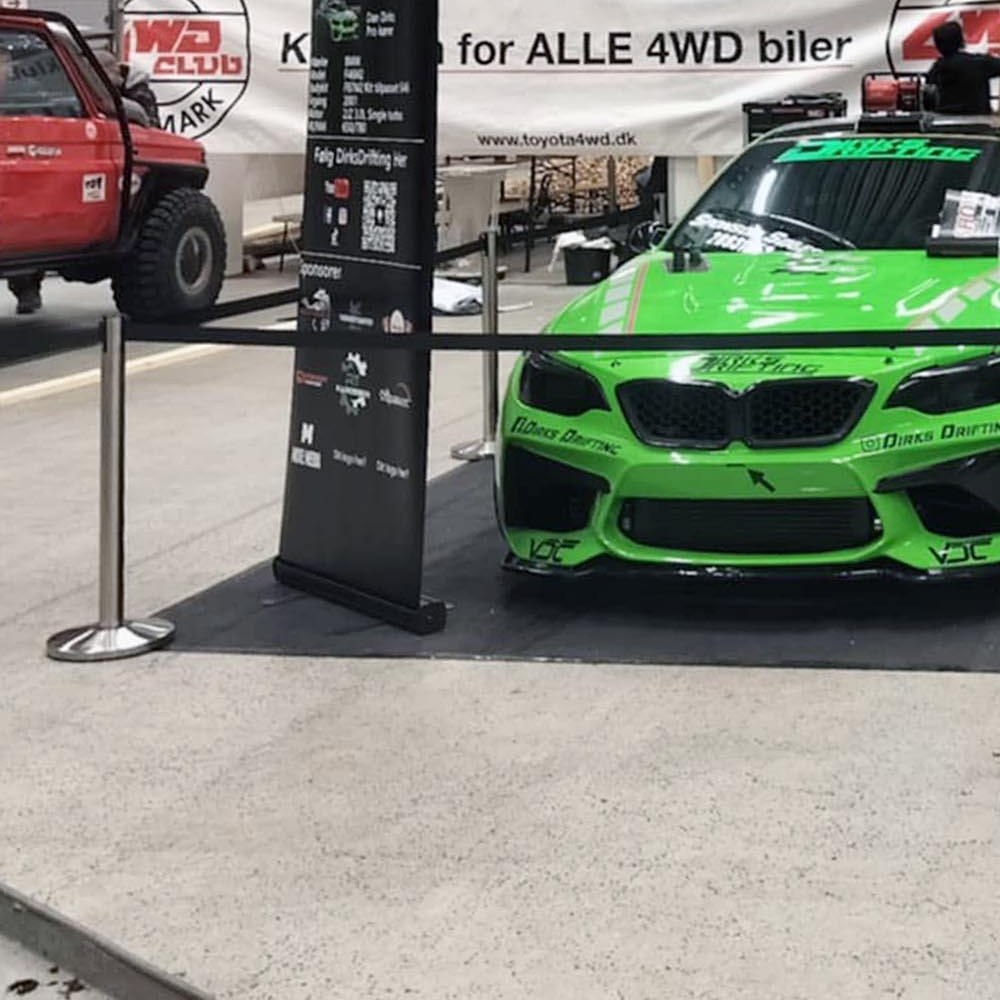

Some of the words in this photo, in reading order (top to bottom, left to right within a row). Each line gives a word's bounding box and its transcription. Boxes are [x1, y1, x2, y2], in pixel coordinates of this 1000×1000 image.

[123, 20, 220, 62] WD
[458, 33, 514, 65] for
[525, 32, 633, 65] ALLE
[646, 30, 743, 64] 4WD
[758, 30, 852, 63] biler
[477, 131, 638, 149] www.toyota4wd.dk
